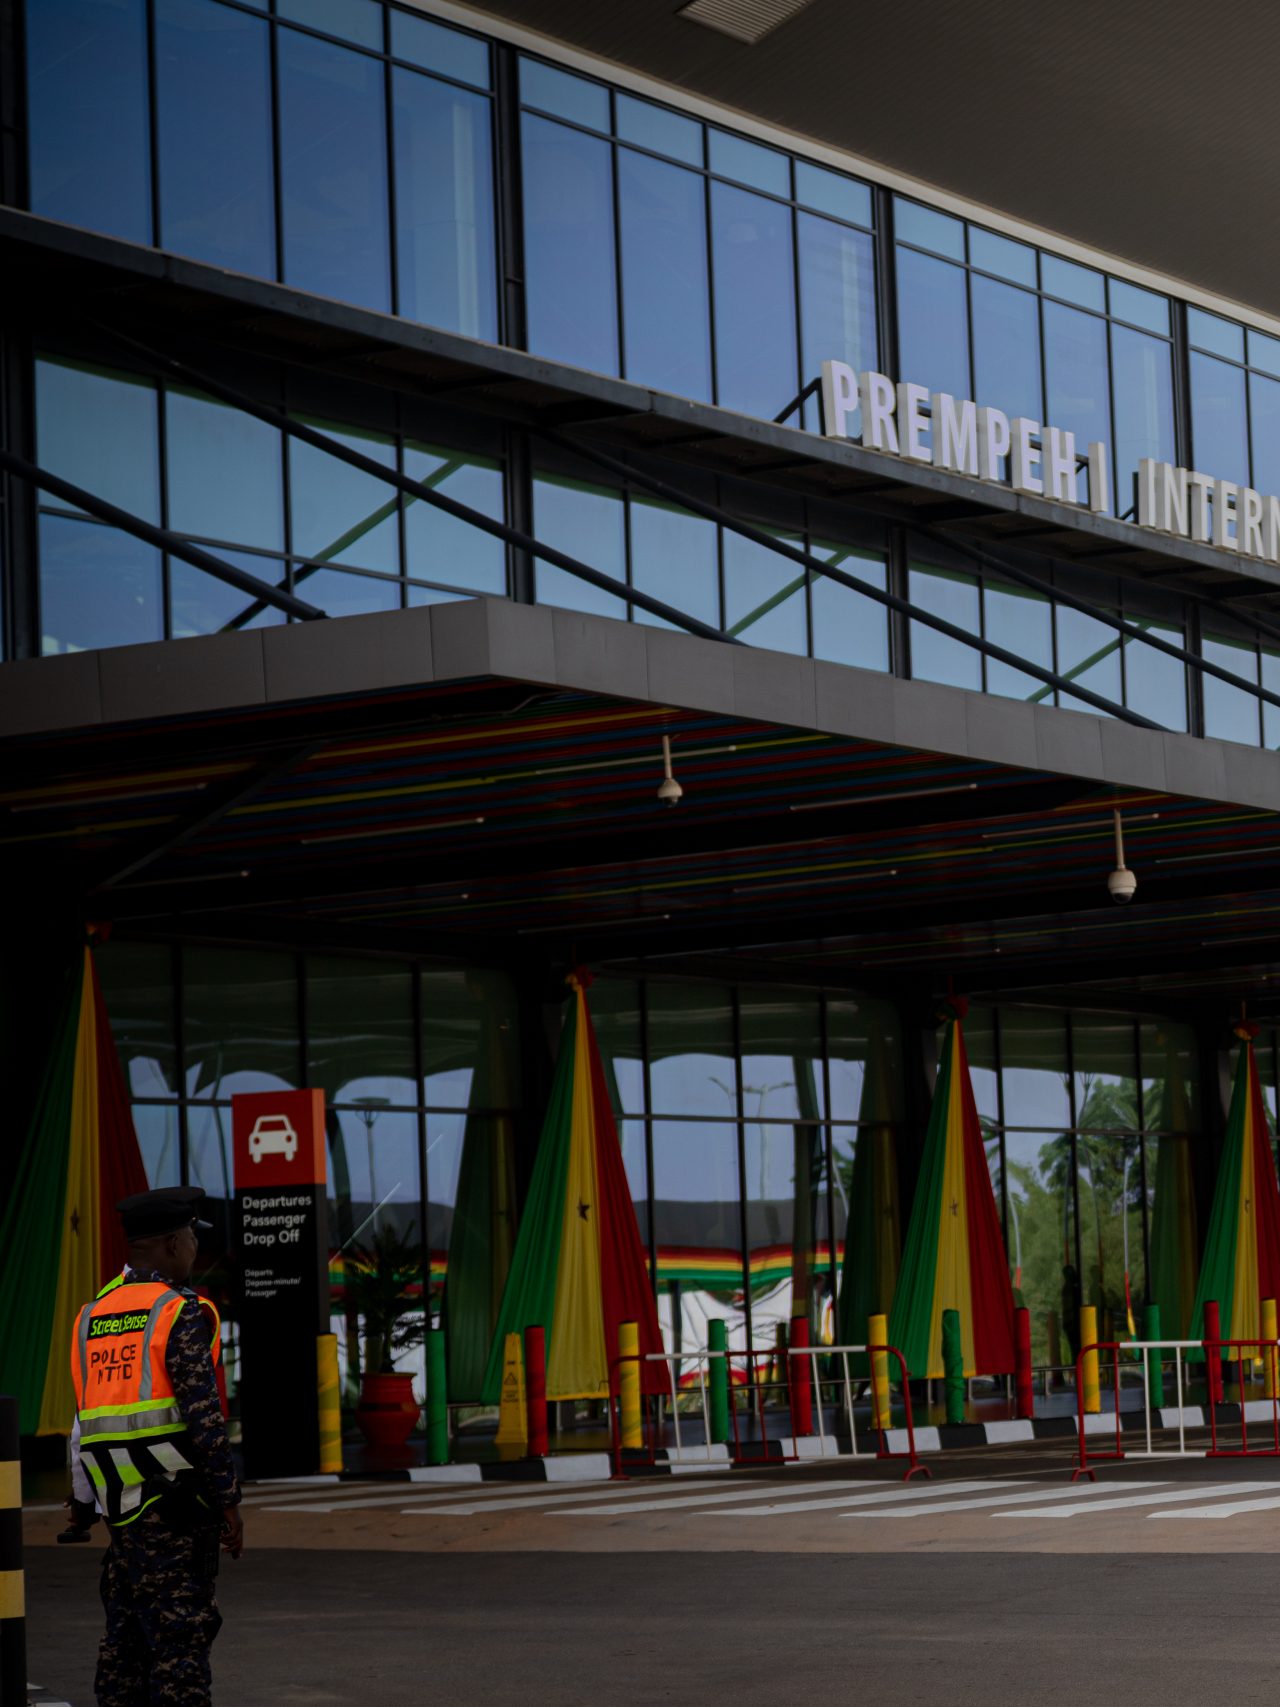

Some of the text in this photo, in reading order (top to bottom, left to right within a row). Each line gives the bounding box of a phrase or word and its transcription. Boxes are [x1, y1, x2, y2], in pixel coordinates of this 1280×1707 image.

[822, 359, 1077, 503] PREMPEH
[1088, 441, 1108, 513] I
[242, 1195, 312, 1212] Departures
[243, 1213, 307, 1229] Passenger
[243, 1228, 301, 1248] Drop Off
